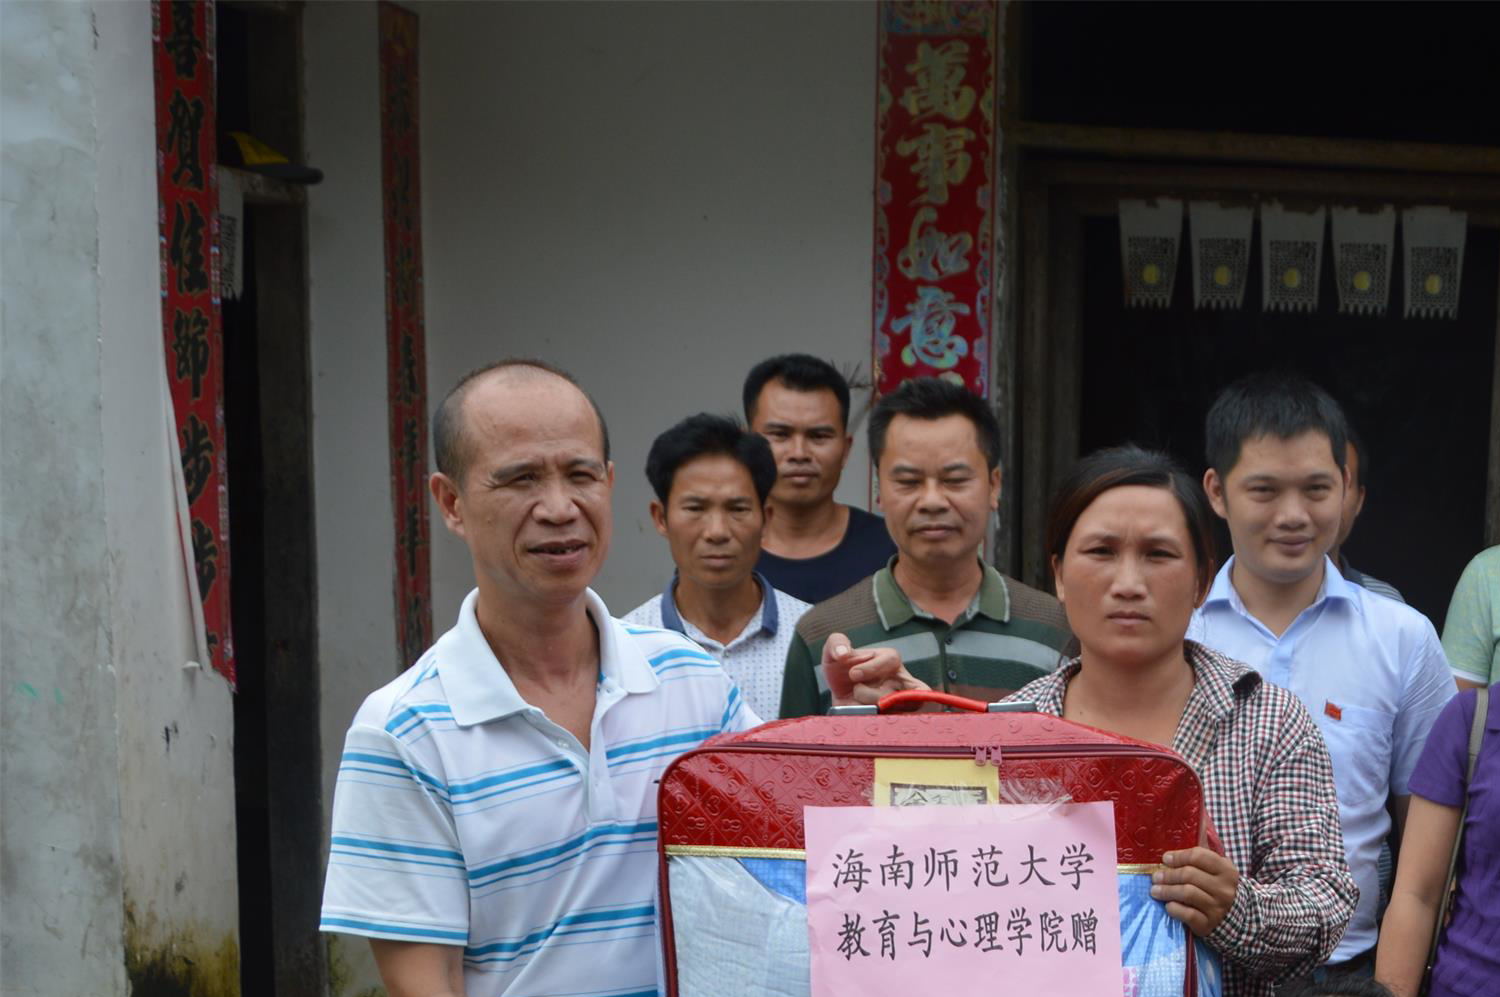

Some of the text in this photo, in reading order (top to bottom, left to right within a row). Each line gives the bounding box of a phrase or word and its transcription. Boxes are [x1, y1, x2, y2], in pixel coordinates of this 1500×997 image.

[890, 39, 976, 388] 萬事如意
[831, 842, 1095, 893] 海南师范大学
[836, 906, 1099, 961] 教育与心理学院赠
